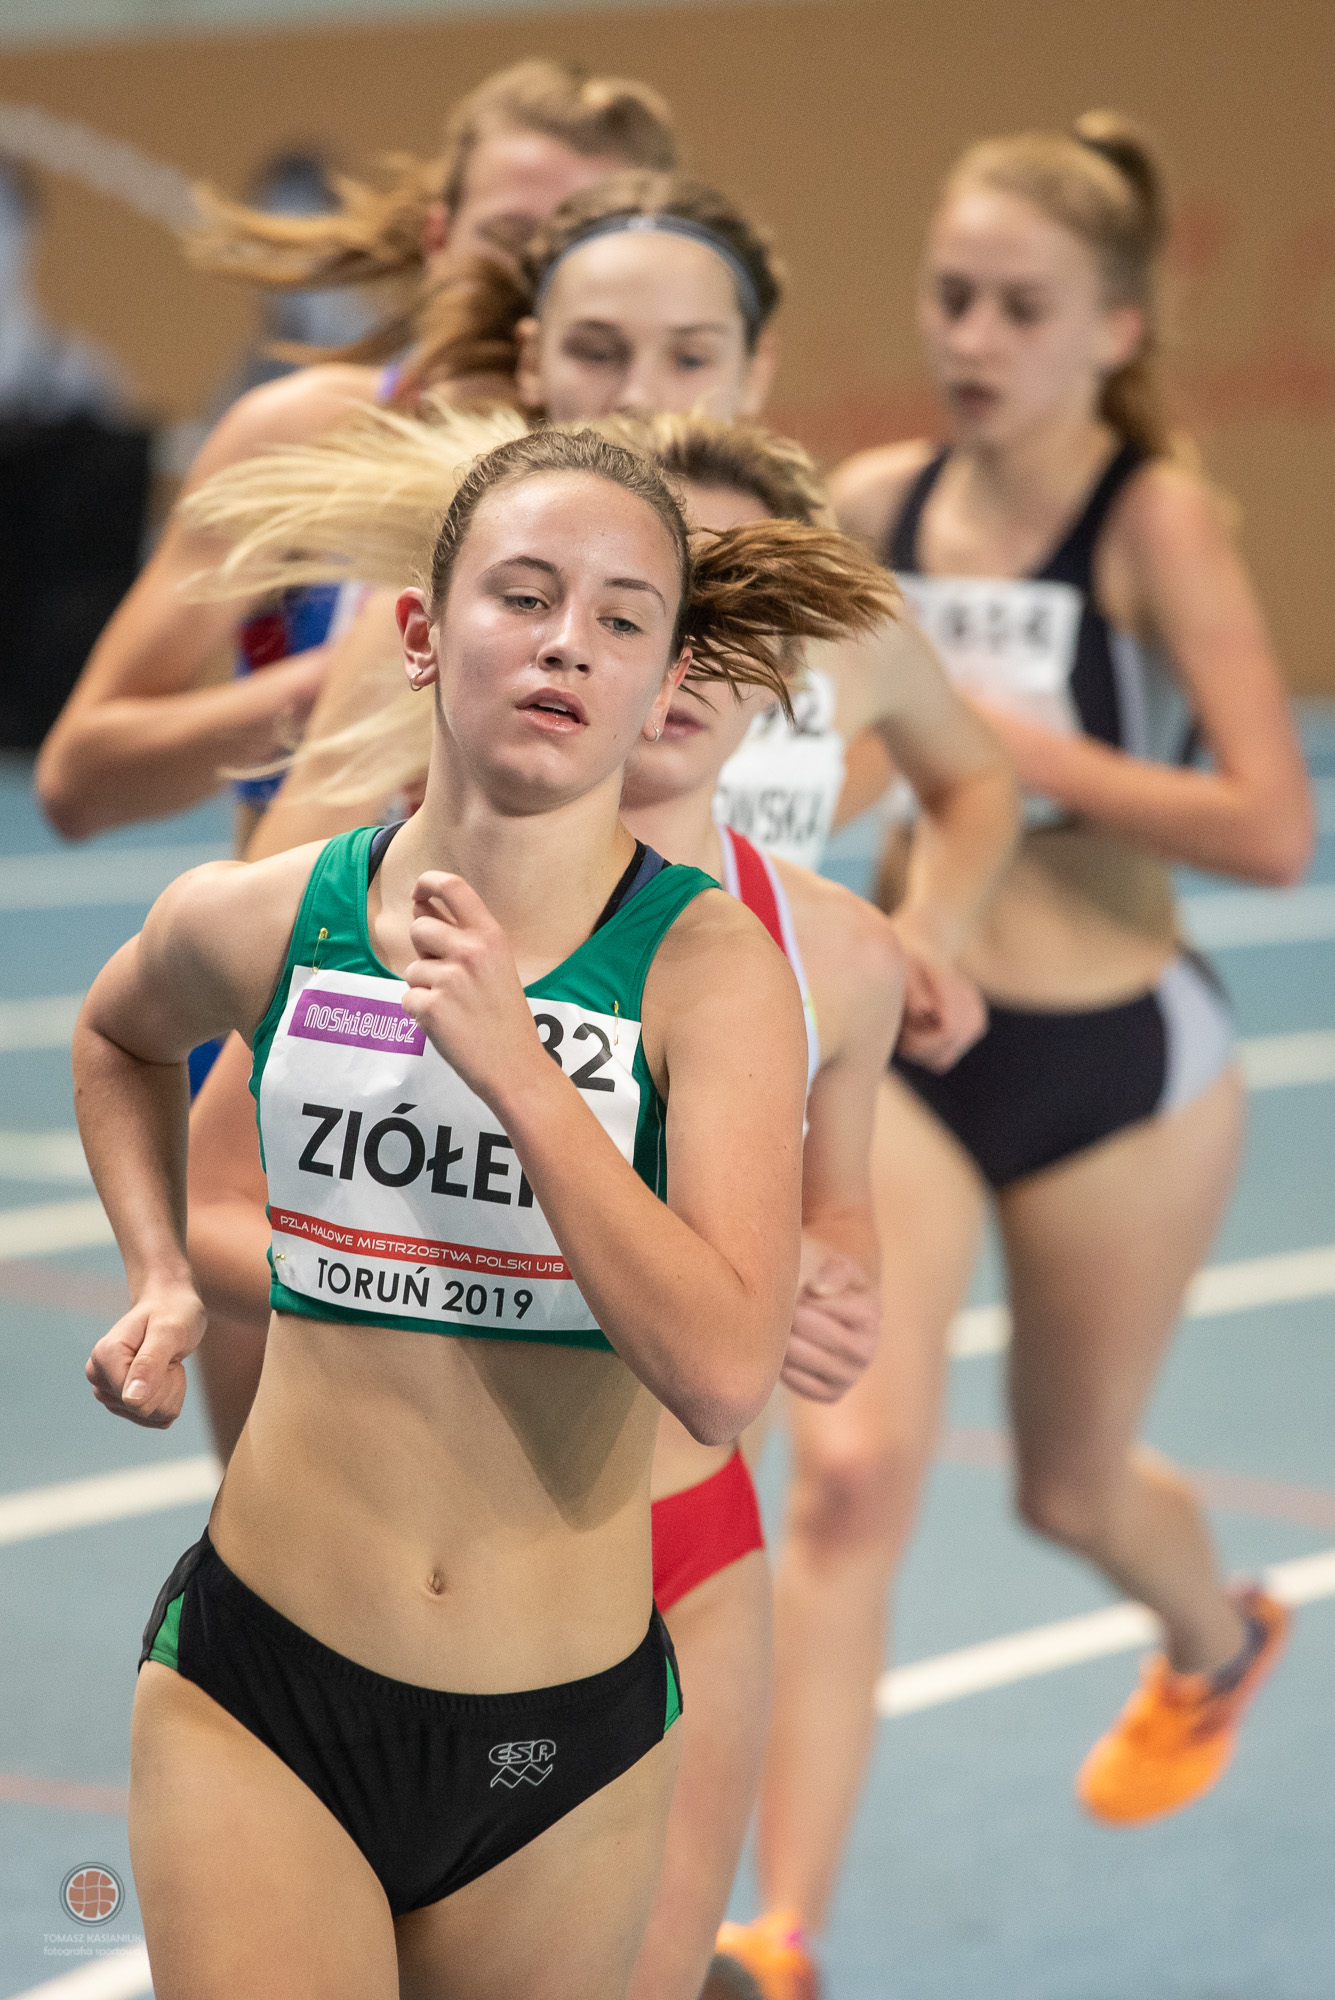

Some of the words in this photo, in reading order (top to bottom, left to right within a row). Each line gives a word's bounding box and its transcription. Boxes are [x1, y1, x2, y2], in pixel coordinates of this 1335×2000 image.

[298, 1103, 537, 1208] ZIÓŁE
[280, 1215, 309, 1232] PZLA
[310, 1223, 353, 1246] HALOWE
[356, 1237, 472, 1264] MISTRZOSTWA
[475, 1255, 531, 1271] POLSKI
[536, 1262, 564, 1273] U18
[317, 1257, 430, 1307] TORUŃ
[441, 1280, 533, 1320] 2019
